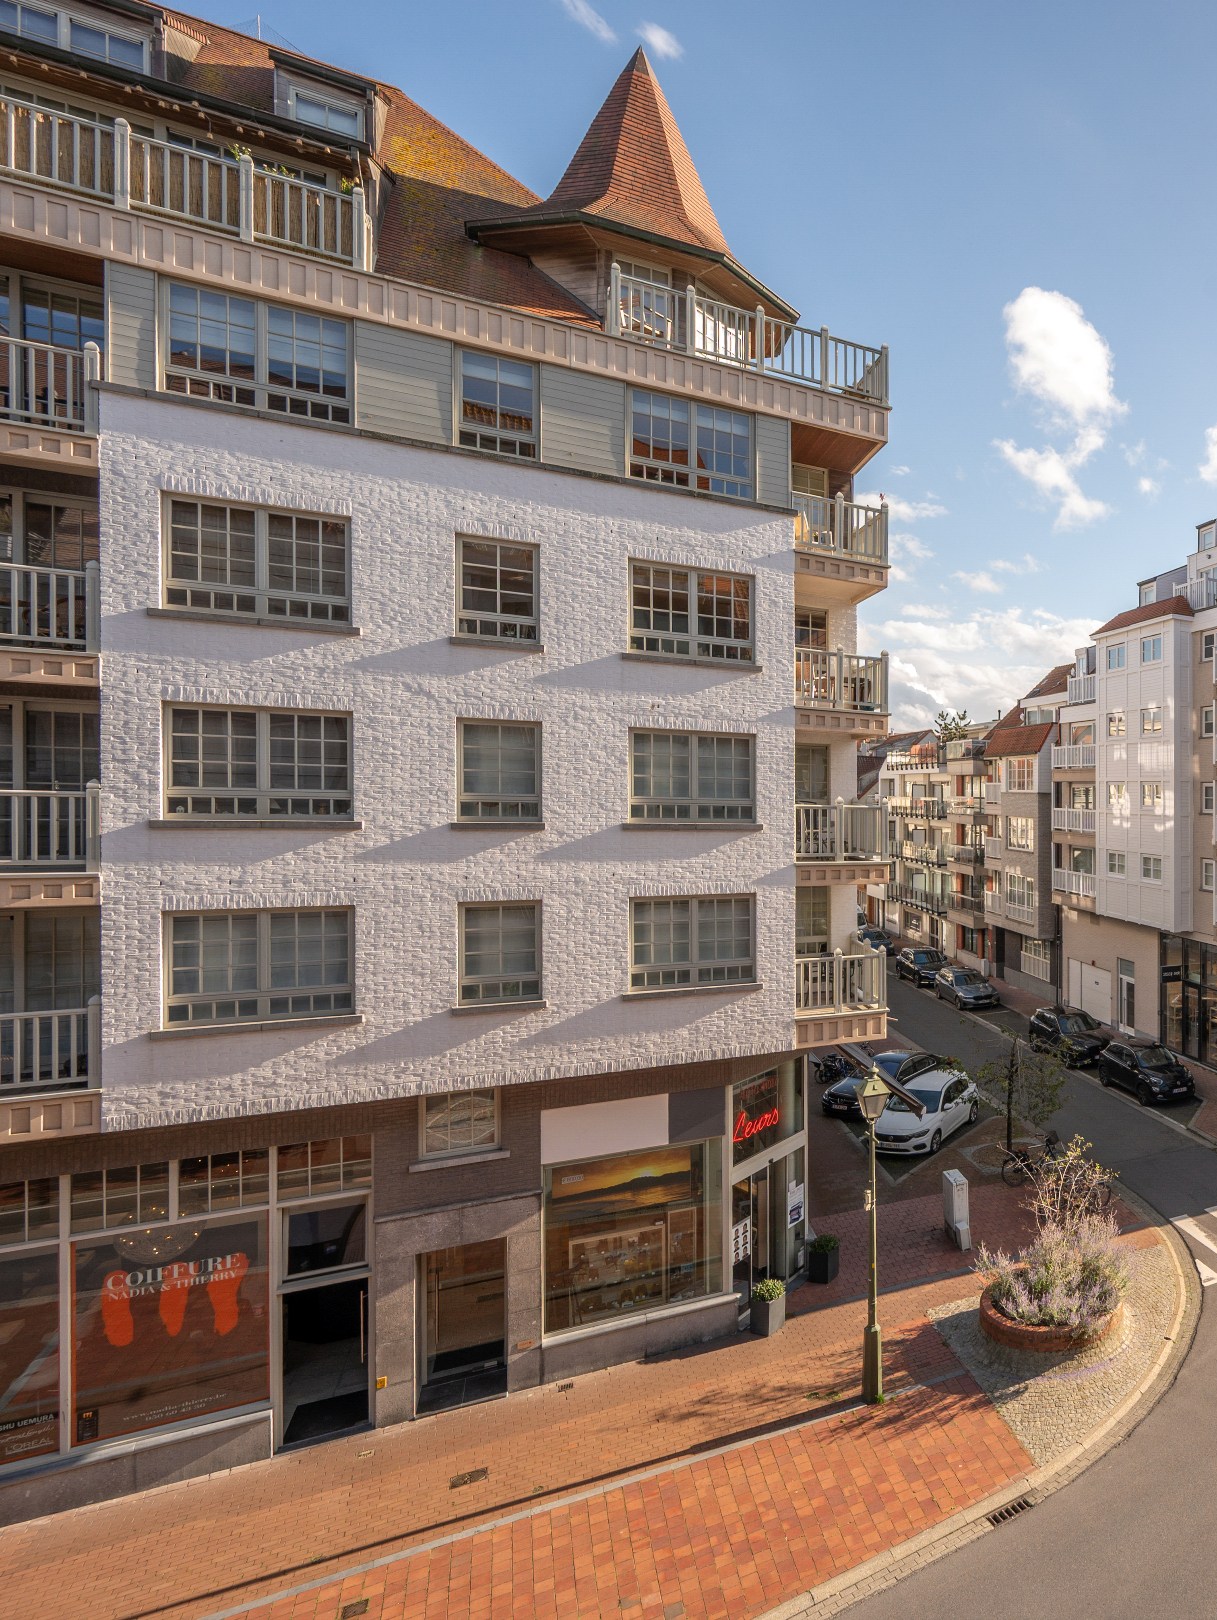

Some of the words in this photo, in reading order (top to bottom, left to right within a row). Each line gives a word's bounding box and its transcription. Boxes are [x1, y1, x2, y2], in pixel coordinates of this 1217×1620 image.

[106, 1252, 241, 1291] COIFFURE
[108, 1285, 155, 1301] NADIA
[160, 1281, 171, 1292] &
[175, 1268, 238, 1289] THIERRY
[17, 1413, 54, 1427] UEMURA
